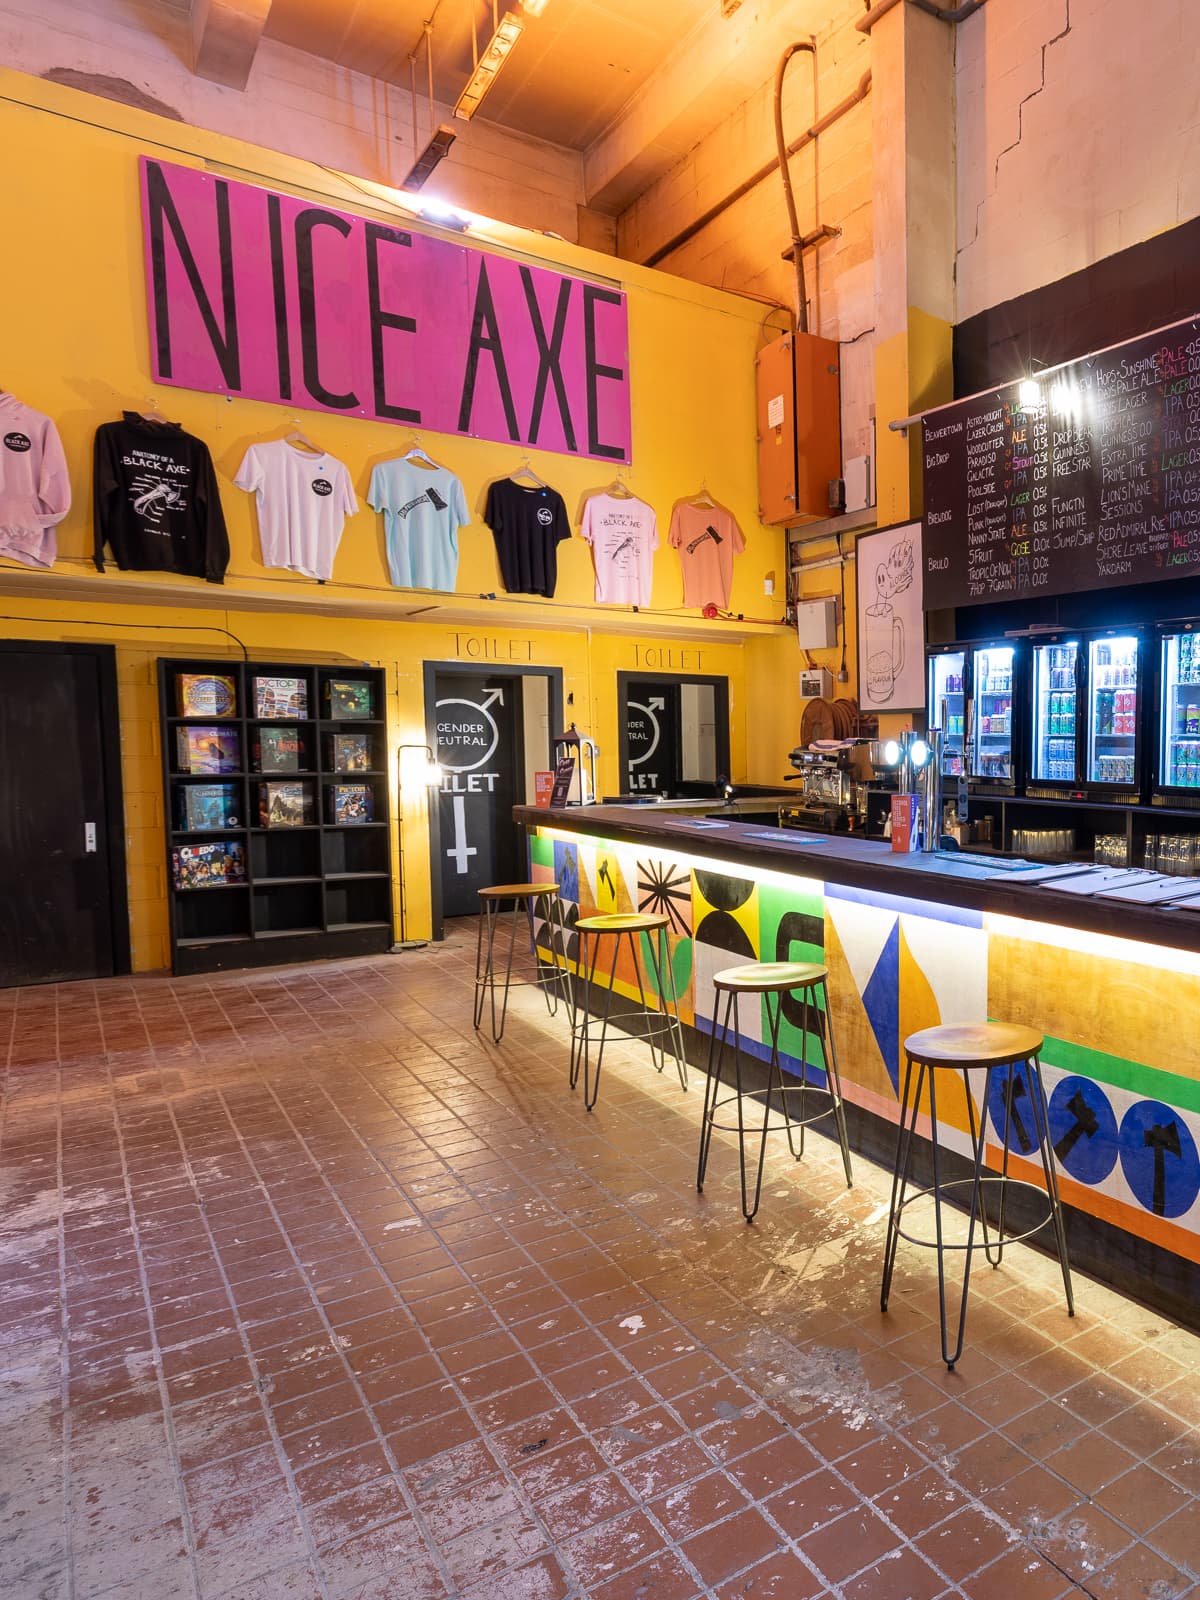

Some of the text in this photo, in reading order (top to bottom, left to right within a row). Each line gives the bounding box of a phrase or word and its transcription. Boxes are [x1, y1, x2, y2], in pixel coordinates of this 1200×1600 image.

[145, 160, 626, 461] NICE AXE
[1120, 354, 1160, 379] SUNSHINE
[1118, 392, 1148, 412] LAGER
[1163, 379, 1190, 397] LAGER
[925, 423, 963, 442] BEAVERTOWN
[1012, 429, 1027, 444] ALE
[123, 456, 187, 474] BLACK AXE
[1012, 456, 1033, 470] STOUT
[1052, 441, 1148, 478] FREE STAR EXTRA TIME
[1102, 454, 1189, 484] PRIME TIME LAGER
[1011, 491, 1030, 506] LAGER
[1129, 480, 1152, 501] MANE
[1052, 500, 1144, 531] INFINITE SESSIONS
[1011, 523, 1027, 538] ALE
[1115, 521, 1151, 539] ADMIRAL
[1151, 515, 1166, 532] RYE
[1010, 540, 1030, 556] GOSE
[1097, 561, 1132, 577] YARDARM
[447, 632, 537, 661] TOILET
[631, 644, 705, 670] TOILET
[437, 723, 484, 733] GENDER
[628, 732, 648, 740] TRAL
[437, 736, 488, 746] EUTRAL
[440, 773, 500, 793] ILET
[629, 773, 658, 790] LET
[180, 844, 215, 859] CLUEDO
